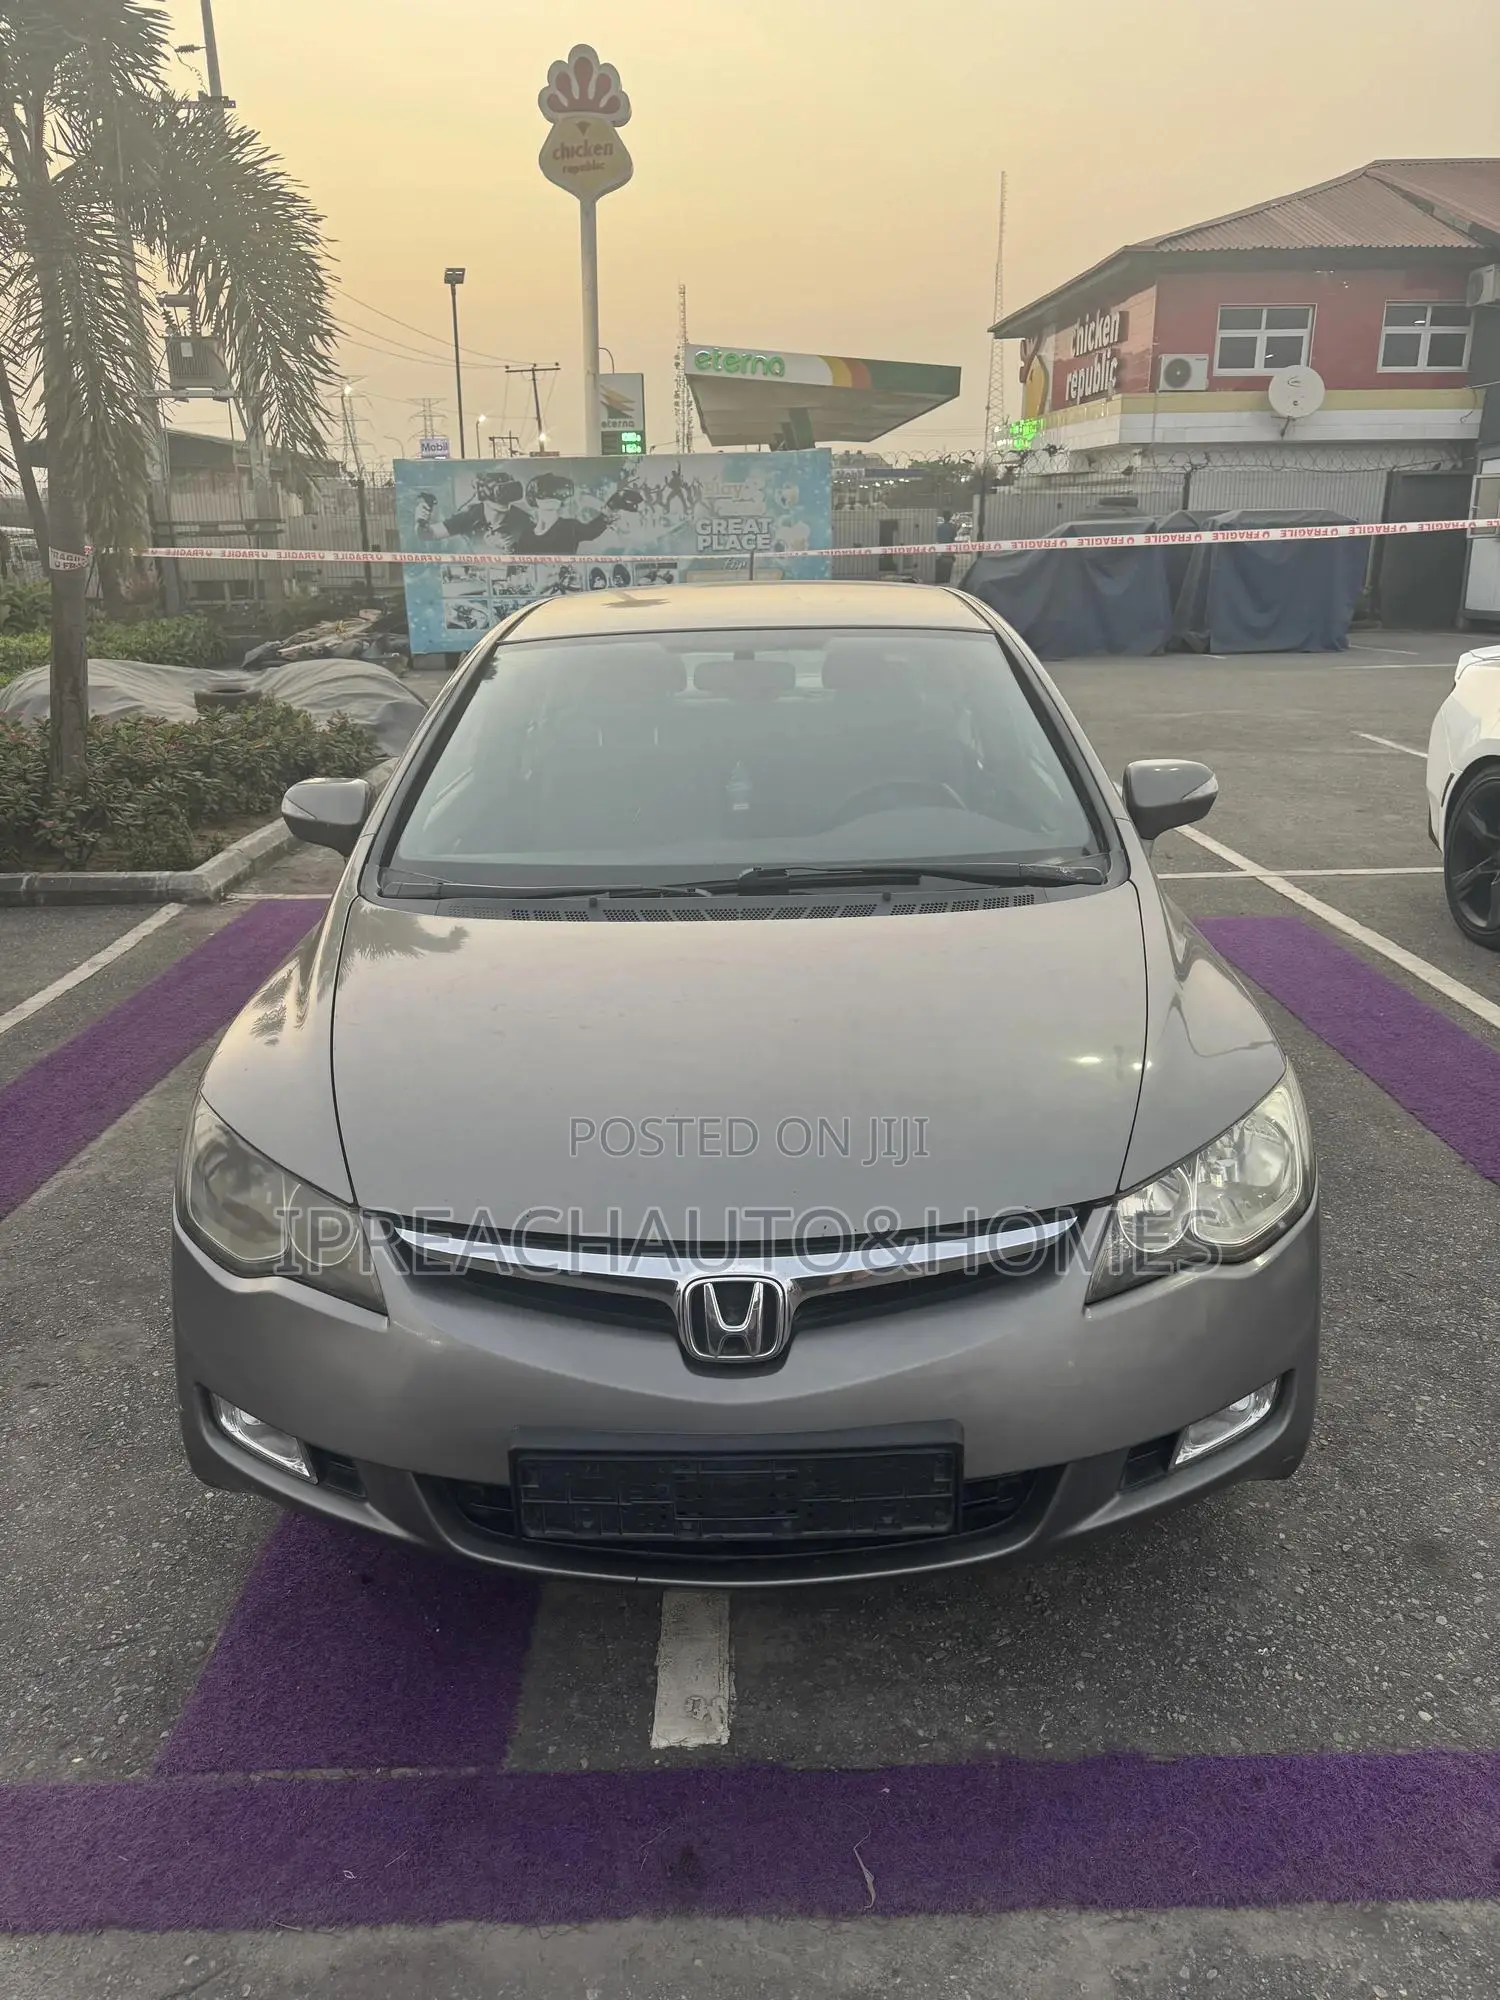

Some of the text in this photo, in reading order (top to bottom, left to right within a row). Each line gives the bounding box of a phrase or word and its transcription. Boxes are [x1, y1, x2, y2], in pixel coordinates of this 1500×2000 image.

[553, 139, 613, 160] chicken
[1071, 308, 1120, 356] chicken
[695, 348, 785, 377] eterna
[1065, 347, 1118, 405] republic
[421, 442, 449, 452] Mobil
[695, 517, 772, 535] GREAT
[1349, 525, 1397, 534] FRAGILE
[1418, 522, 1466, 531] FRAGILE
[1144, 533, 1191, 543] FRAGILE
[1212, 531, 1260, 540] FRAGILE
[1280, 528, 1328, 538] FRAGILE
[697, 535, 772, 551] PLACE
[1011, 540, 1053, 549] FRAGILE
[1077, 536, 1124, 546] FRAGILE
[946, 542, 992, 552] FRAGILE
